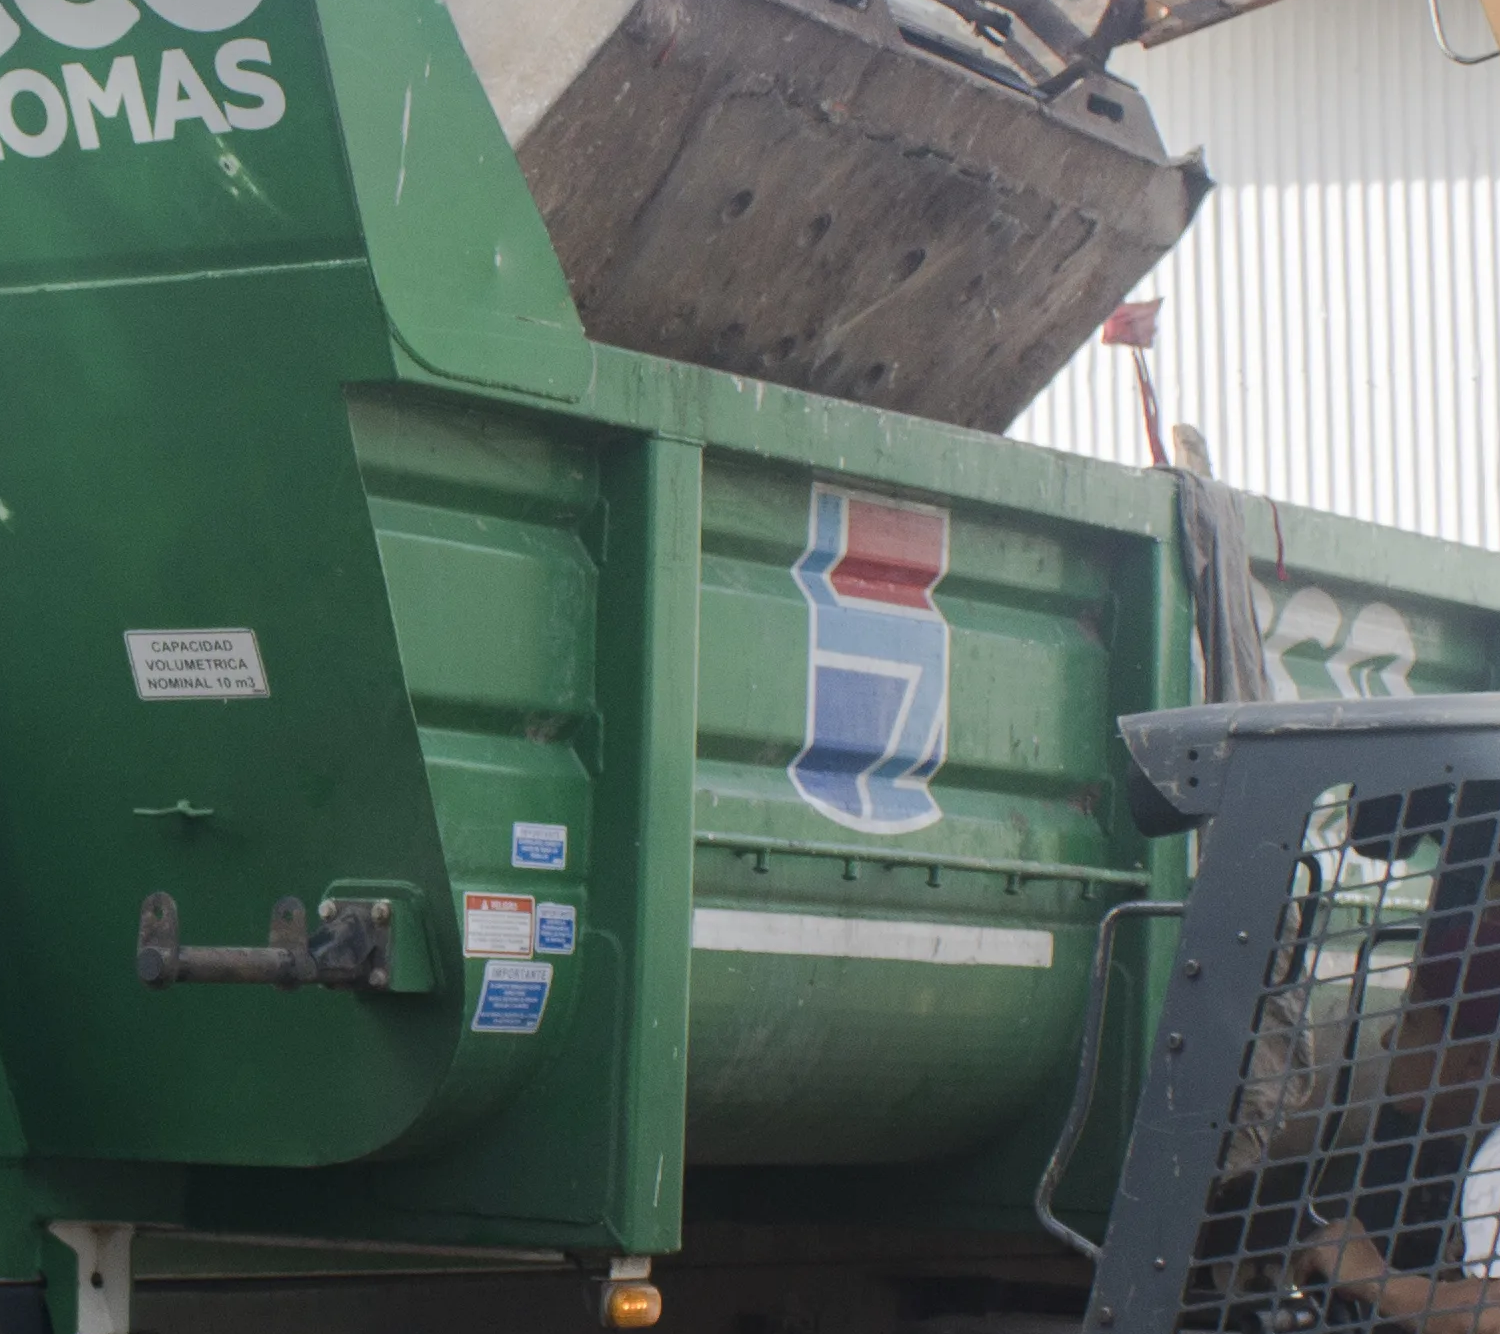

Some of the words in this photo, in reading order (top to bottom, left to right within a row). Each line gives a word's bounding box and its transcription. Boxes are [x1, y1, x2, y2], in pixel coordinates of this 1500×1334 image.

[151, 640, 233, 653] CAPACIDAD
[145, 658, 249, 672] VOLUMETRICA
[147, 677, 213, 690] NOMINAL
[217, 677, 231, 689] 10
